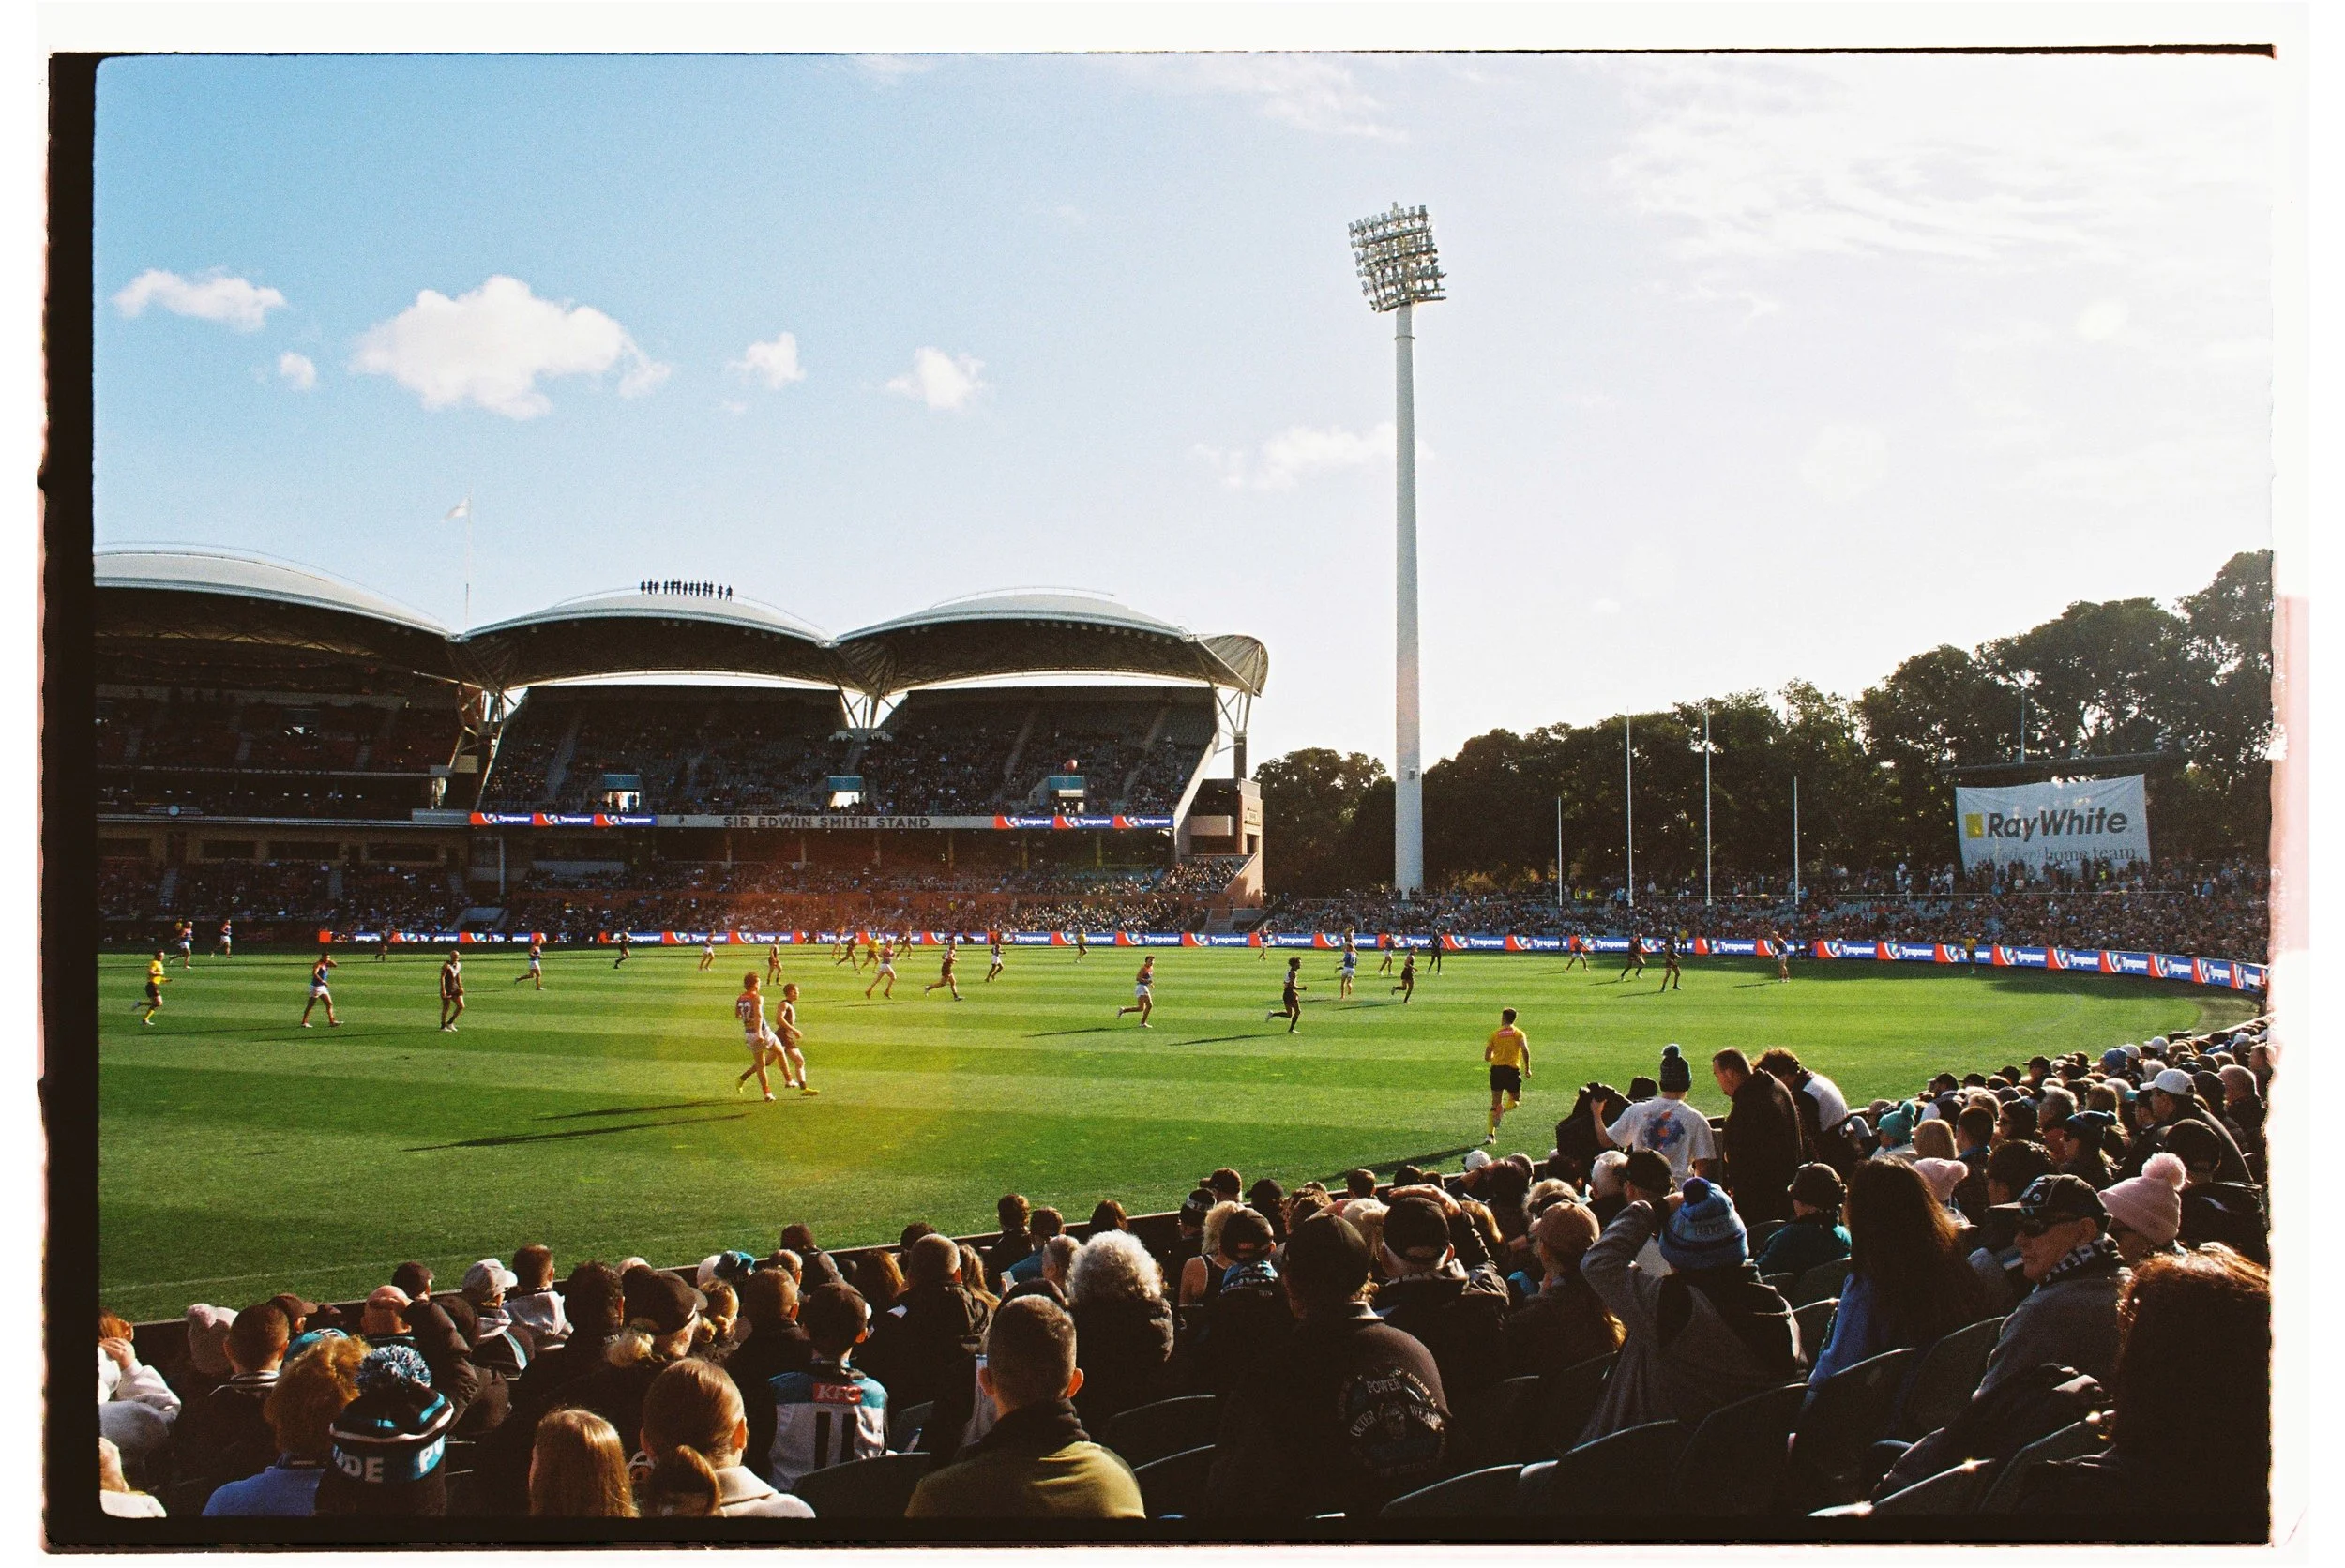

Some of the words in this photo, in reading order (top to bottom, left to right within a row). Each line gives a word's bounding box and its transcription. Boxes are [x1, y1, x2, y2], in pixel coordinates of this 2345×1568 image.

[723, 816, 749, 827] SIR
[757, 816, 811, 827] EDWIN
[820, 817, 869, 828] SMITH
[876, 817, 930, 828] STAND
[1020, 817, 1051, 825] Tyrepower
[1080, 817, 1113, 825] Tyrepower
[1139, 817, 1171, 825] Tyrepower
[2044, 846, 2088, 862] home
[2093, 846, 2136, 862] team
[1015, 934, 1051, 943] Tyrepower
[1143, 935, 1180, 944] Tyrepower
[1277, 936, 1312, 945] Tyrepower
[1469, 938, 1504, 947] Tyrepower
[1366, 1378, 1402, 1394] POWER
[817, 1384, 862, 1401] KFC
[1349, 1410, 1378, 1437] OUTER
